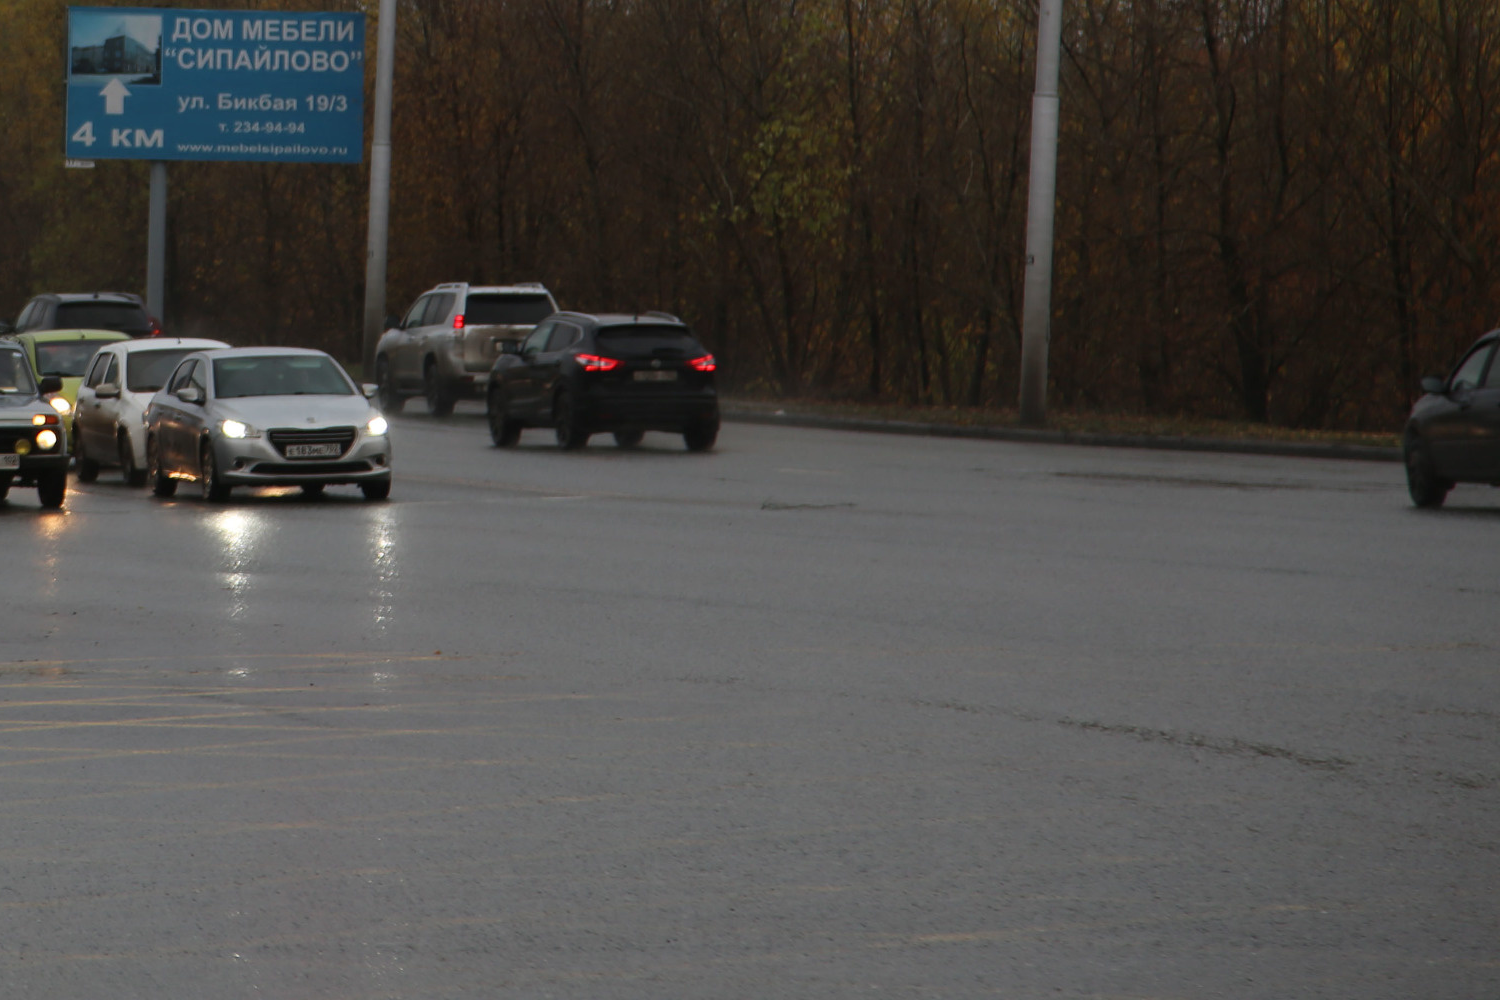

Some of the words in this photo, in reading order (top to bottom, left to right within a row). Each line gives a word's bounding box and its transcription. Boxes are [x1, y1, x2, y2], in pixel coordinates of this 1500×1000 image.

[172, 18, 234, 44] ДОМ
[242, 20, 355, 42] МЕБЕЛИ
[178, 95, 210, 113] ул.
[217, 94, 298, 111] Бикбая
[305, 95, 348, 113] 19/3
[71, 120, 97, 147] 4
[219, 123, 230, 133] т.
[233, 121, 306, 134] 234-94-94
[177, 143, 348, 156] www.mebelsipailovo.ru
